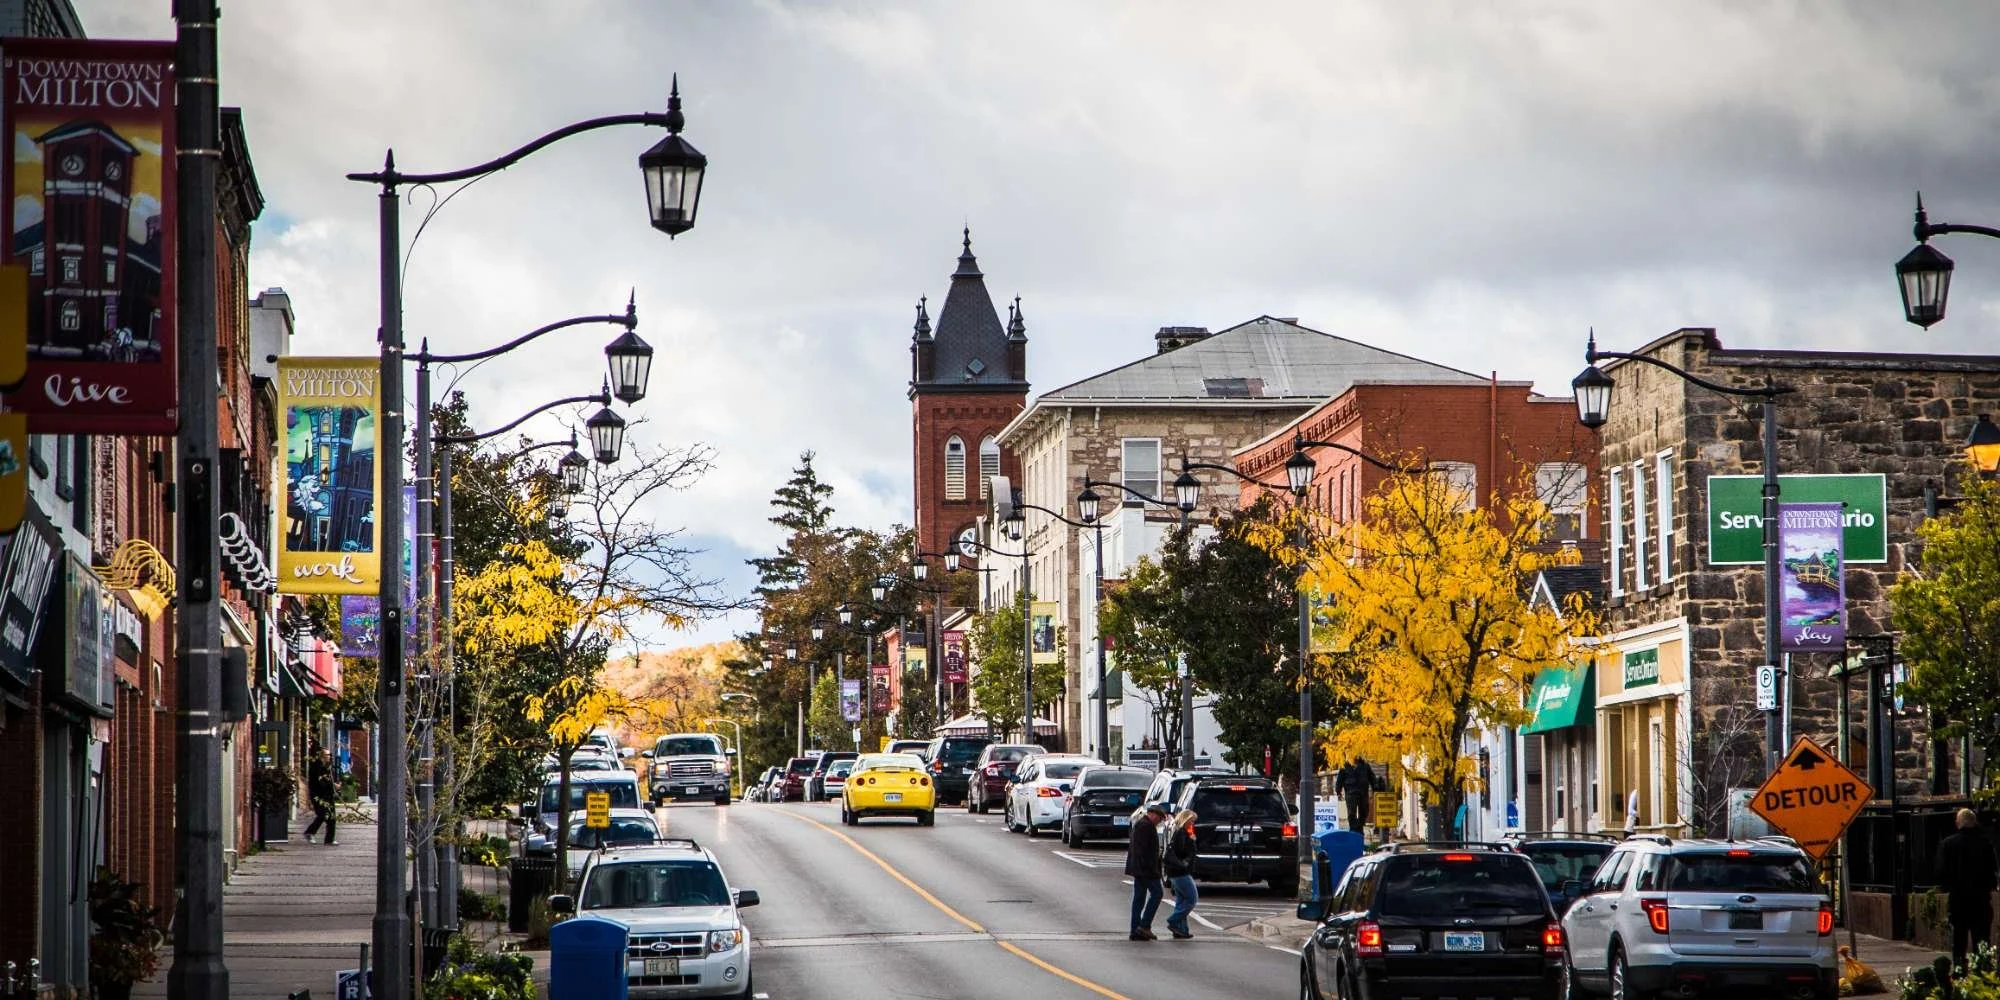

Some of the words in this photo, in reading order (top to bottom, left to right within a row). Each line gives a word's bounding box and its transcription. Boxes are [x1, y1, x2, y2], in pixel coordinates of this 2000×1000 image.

[18, 60, 161, 80] DOWNTOWN
[16, 78, 162, 108] MILTON
[287, 368, 373, 379] DOWNTOWN
[287, 379, 375, 397] MILTON
[1783, 510, 1838, 518] DOWNTOWN
[1783, 517, 1838, 529] MILTON
[294, 554, 364, 584] work
[1794, 626, 1832, 645] play
[1764, 782, 1857, 811] DETOUR
